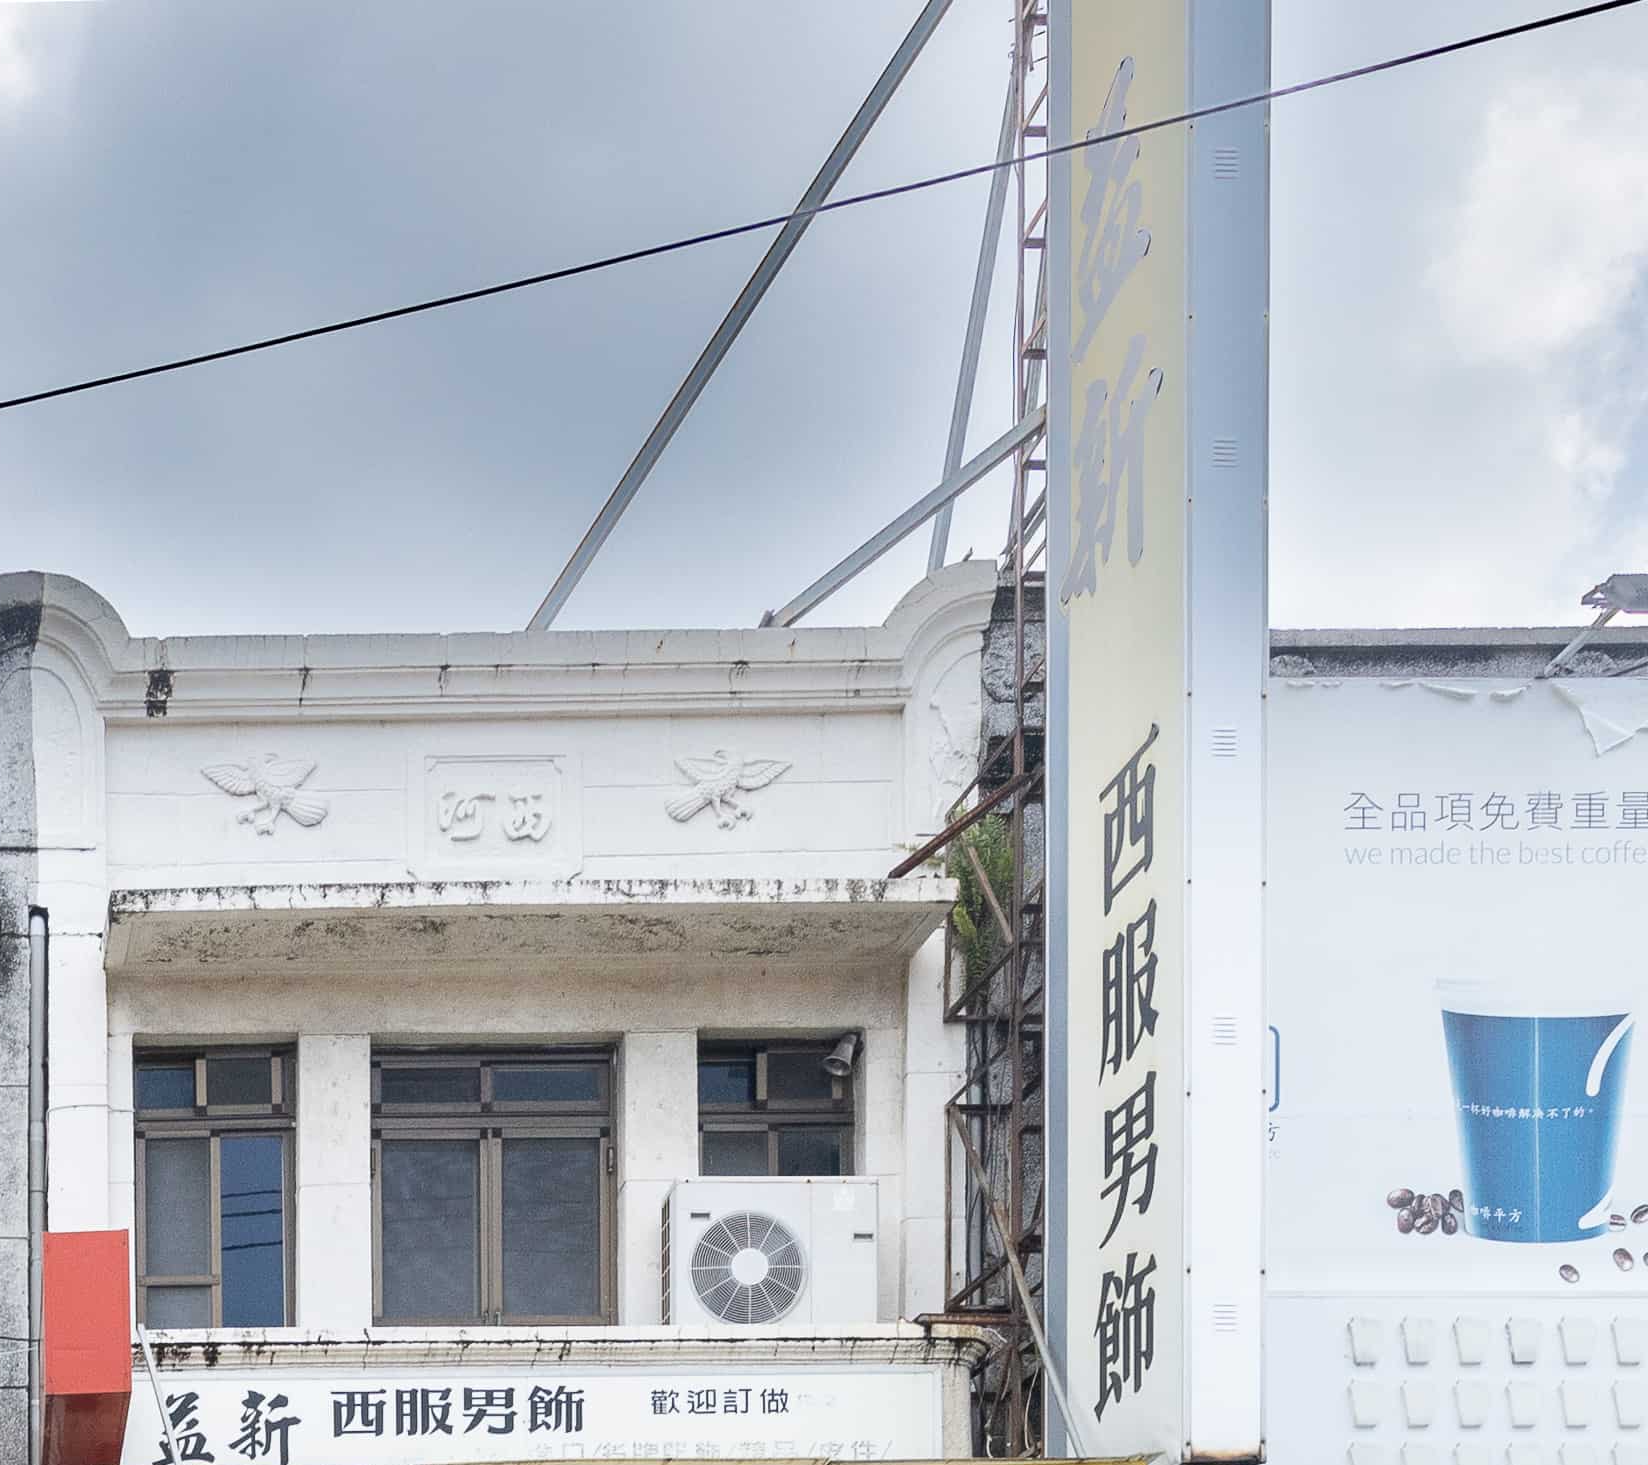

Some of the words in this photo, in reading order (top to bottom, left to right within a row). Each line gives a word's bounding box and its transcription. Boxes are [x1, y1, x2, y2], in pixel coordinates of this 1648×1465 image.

[1343, 846, 1384, 865] we
[1389, 839, 1463, 866] made
[1468, 839, 1512, 866] the
[1517, 839, 1576, 866] best
[1093, 721, 1161, 1424] 西服男飾
[330, 1384, 586, 1438] 西服男飾
[650, 1387, 790, 1416] 歡迎訂做
